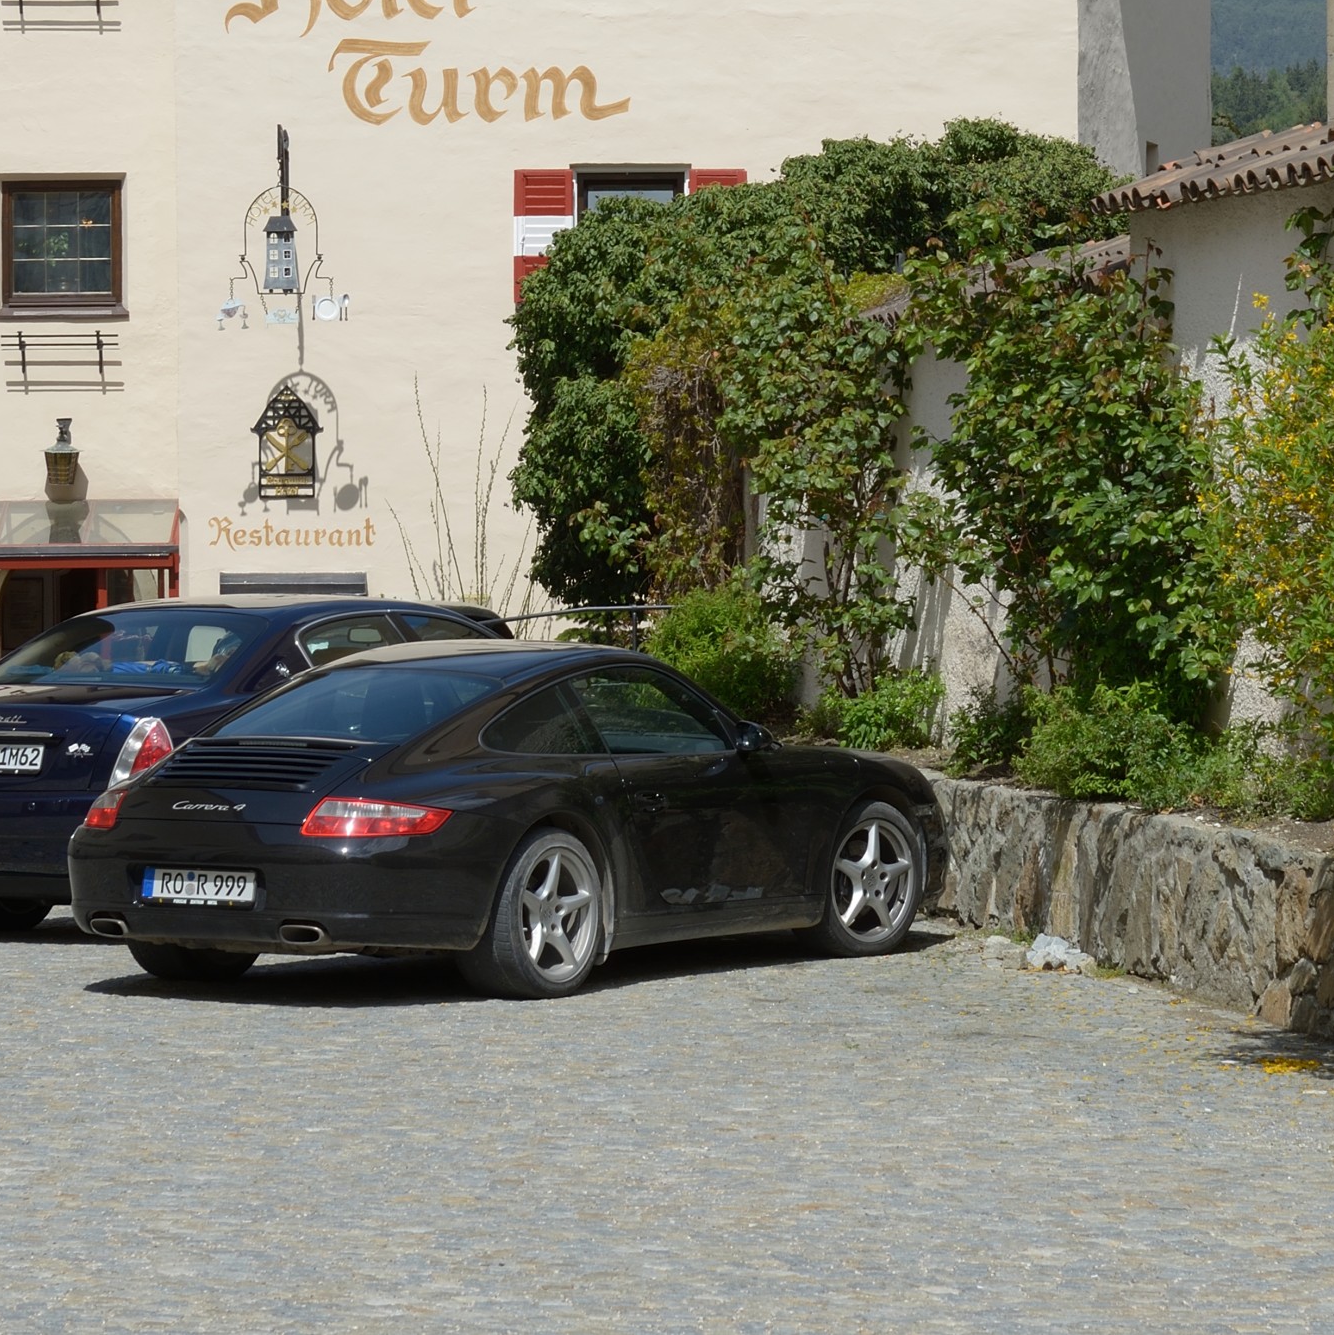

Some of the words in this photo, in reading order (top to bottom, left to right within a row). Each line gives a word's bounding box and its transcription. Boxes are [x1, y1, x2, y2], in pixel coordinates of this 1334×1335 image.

[328, 38, 631, 126] Turm
[246, 190, 279, 226] HOTEL
[288, 190, 316, 226] TURM
[208, 516, 377, 552] Restaurant
[172, 800, 229, 811] Carrera
[233, 804, 246, 812] 4
[160, 872, 184, 894] RO
[196, 873, 208, 895] R
[213, 874, 247, 897] 999
